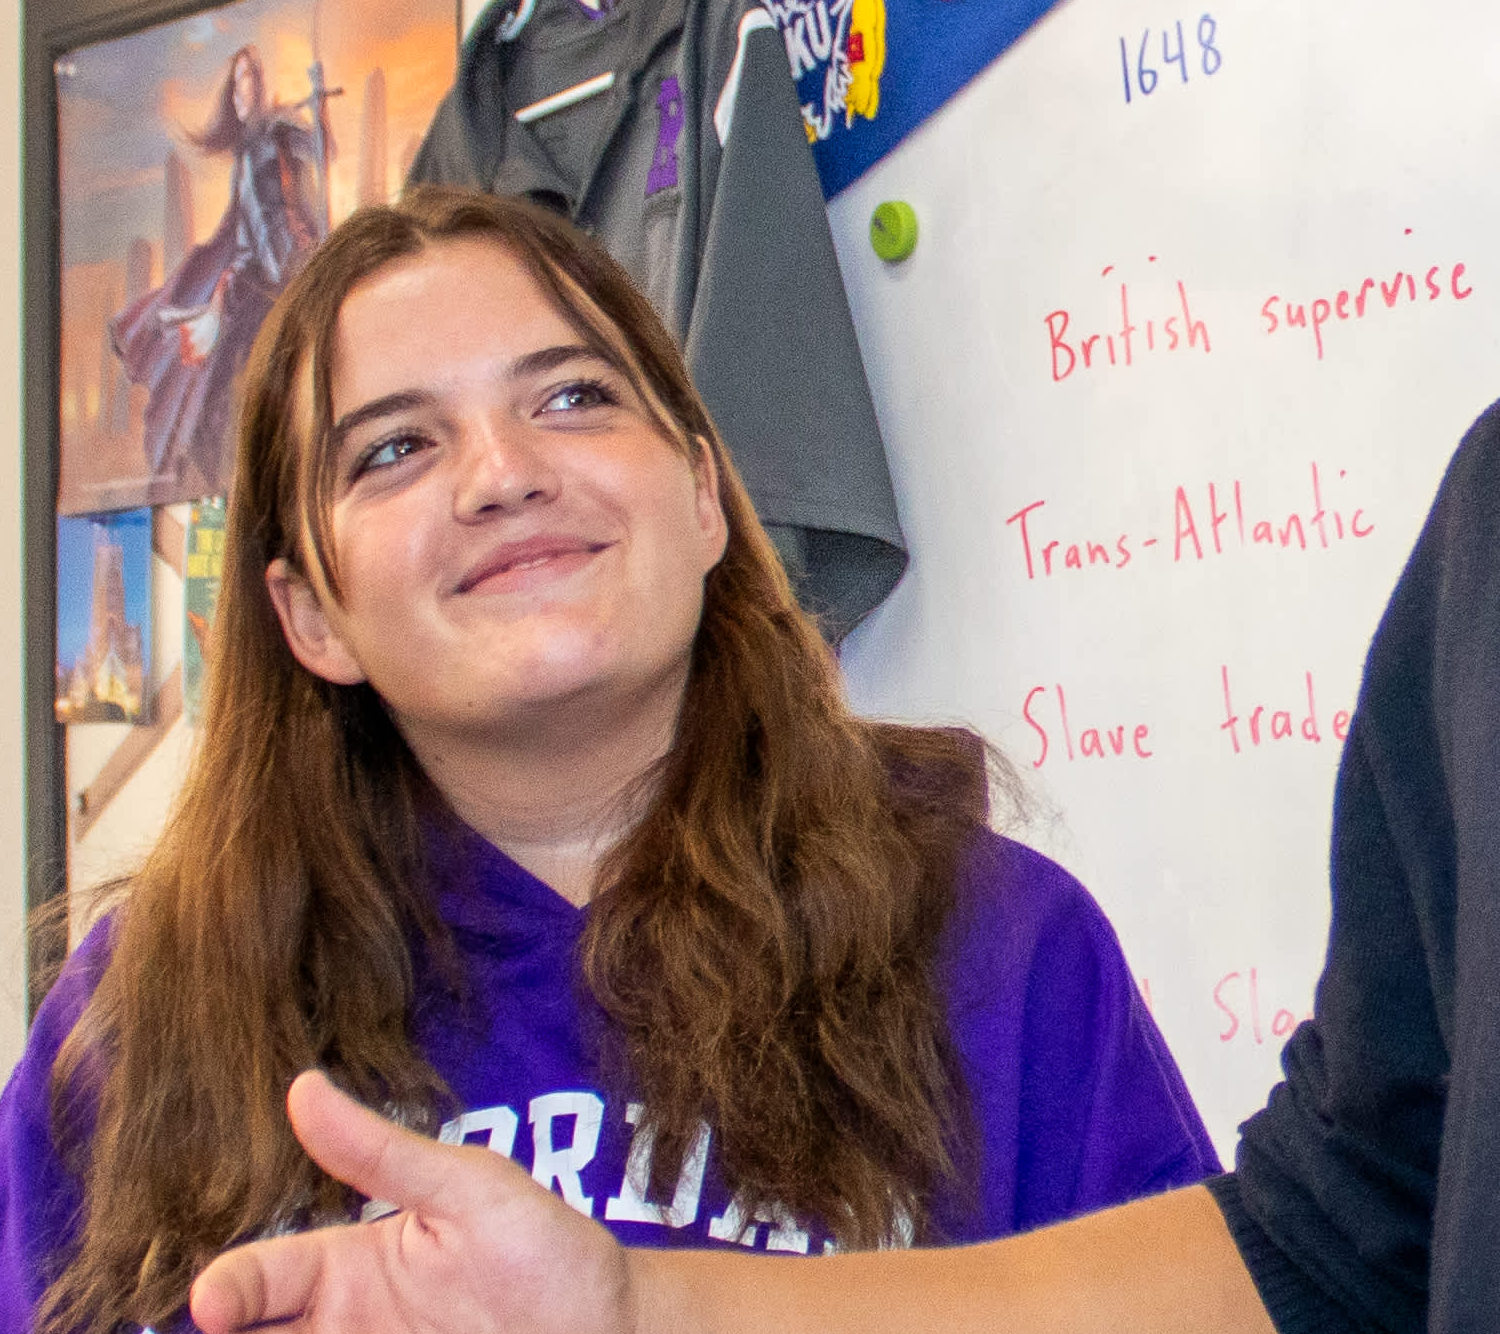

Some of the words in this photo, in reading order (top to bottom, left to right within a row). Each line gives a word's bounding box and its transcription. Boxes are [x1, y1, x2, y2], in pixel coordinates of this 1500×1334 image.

[1119, 13, 1224, 105] 1648
[1043, 255, 1212, 382] British
[1260, 227, 1475, 361] supervise
[1006, 460, 1376, 582] Trans-Atlantic
[1021, 683, 1154, 769] Slave
[1220, 664, 1350, 753] trade
